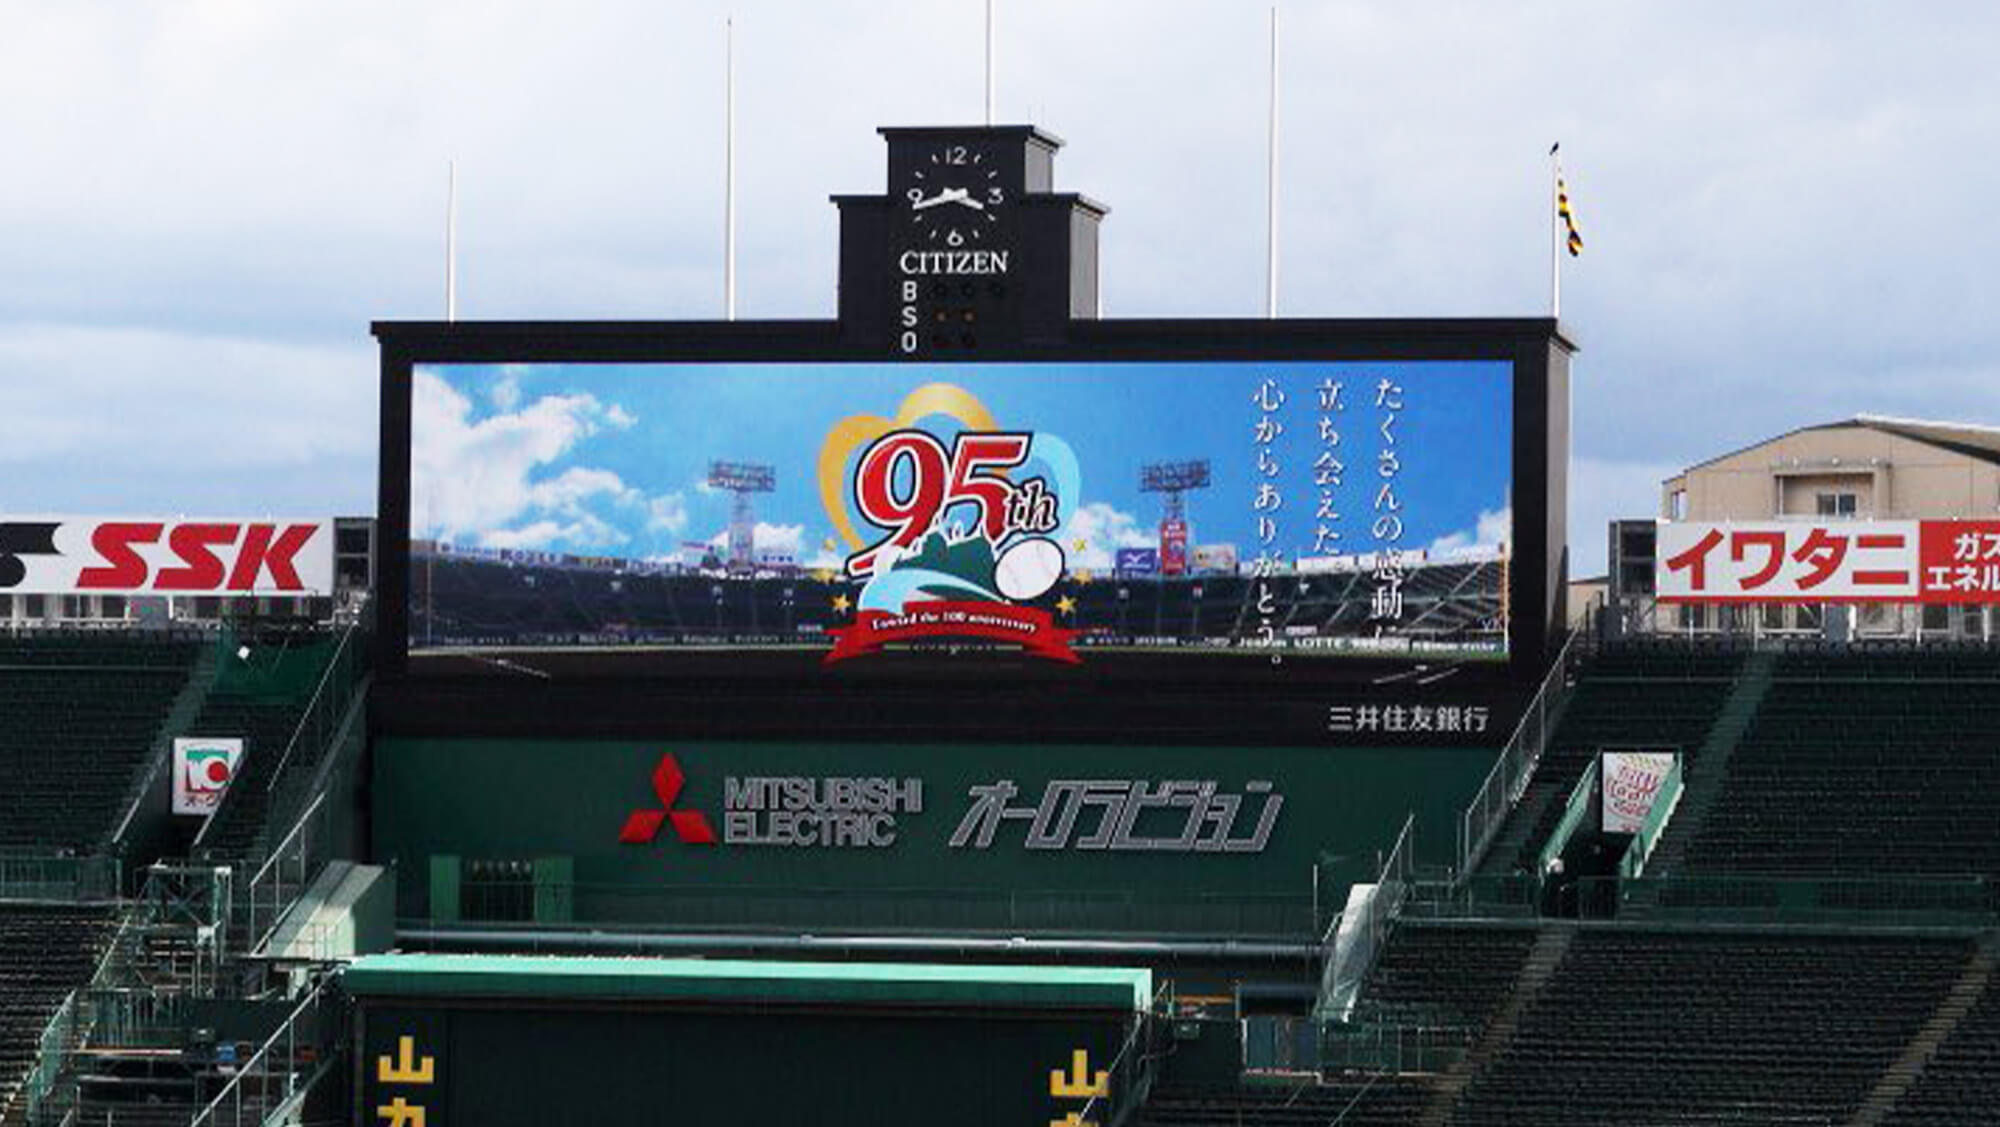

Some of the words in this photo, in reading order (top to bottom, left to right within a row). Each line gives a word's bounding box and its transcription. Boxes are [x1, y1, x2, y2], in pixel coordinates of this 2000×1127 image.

[945, 146, 967, 165] 12
[906, 187, 923, 207] 9
[987, 186, 1003, 204] 3
[946, 229, 964, 247] 6
[899, 250, 1009, 275] CITIZEN
[902, 280, 917, 301] B
[902, 306, 918, 326] S
[1314, 377, 1344, 555] 立ち会えた
[76, 522, 320, 590] SSK
[1666, 527, 1910, 592] イワタニ
[1954, 532, 2000, 560] ガス
[1328, 704, 1489, 732] 三井住友銀行
[724, 776, 923, 813] MITSUBISHI
[724, 811, 896, 847] ELECTRIC
[948, 780, 1284, 853] オーロラビジョン
